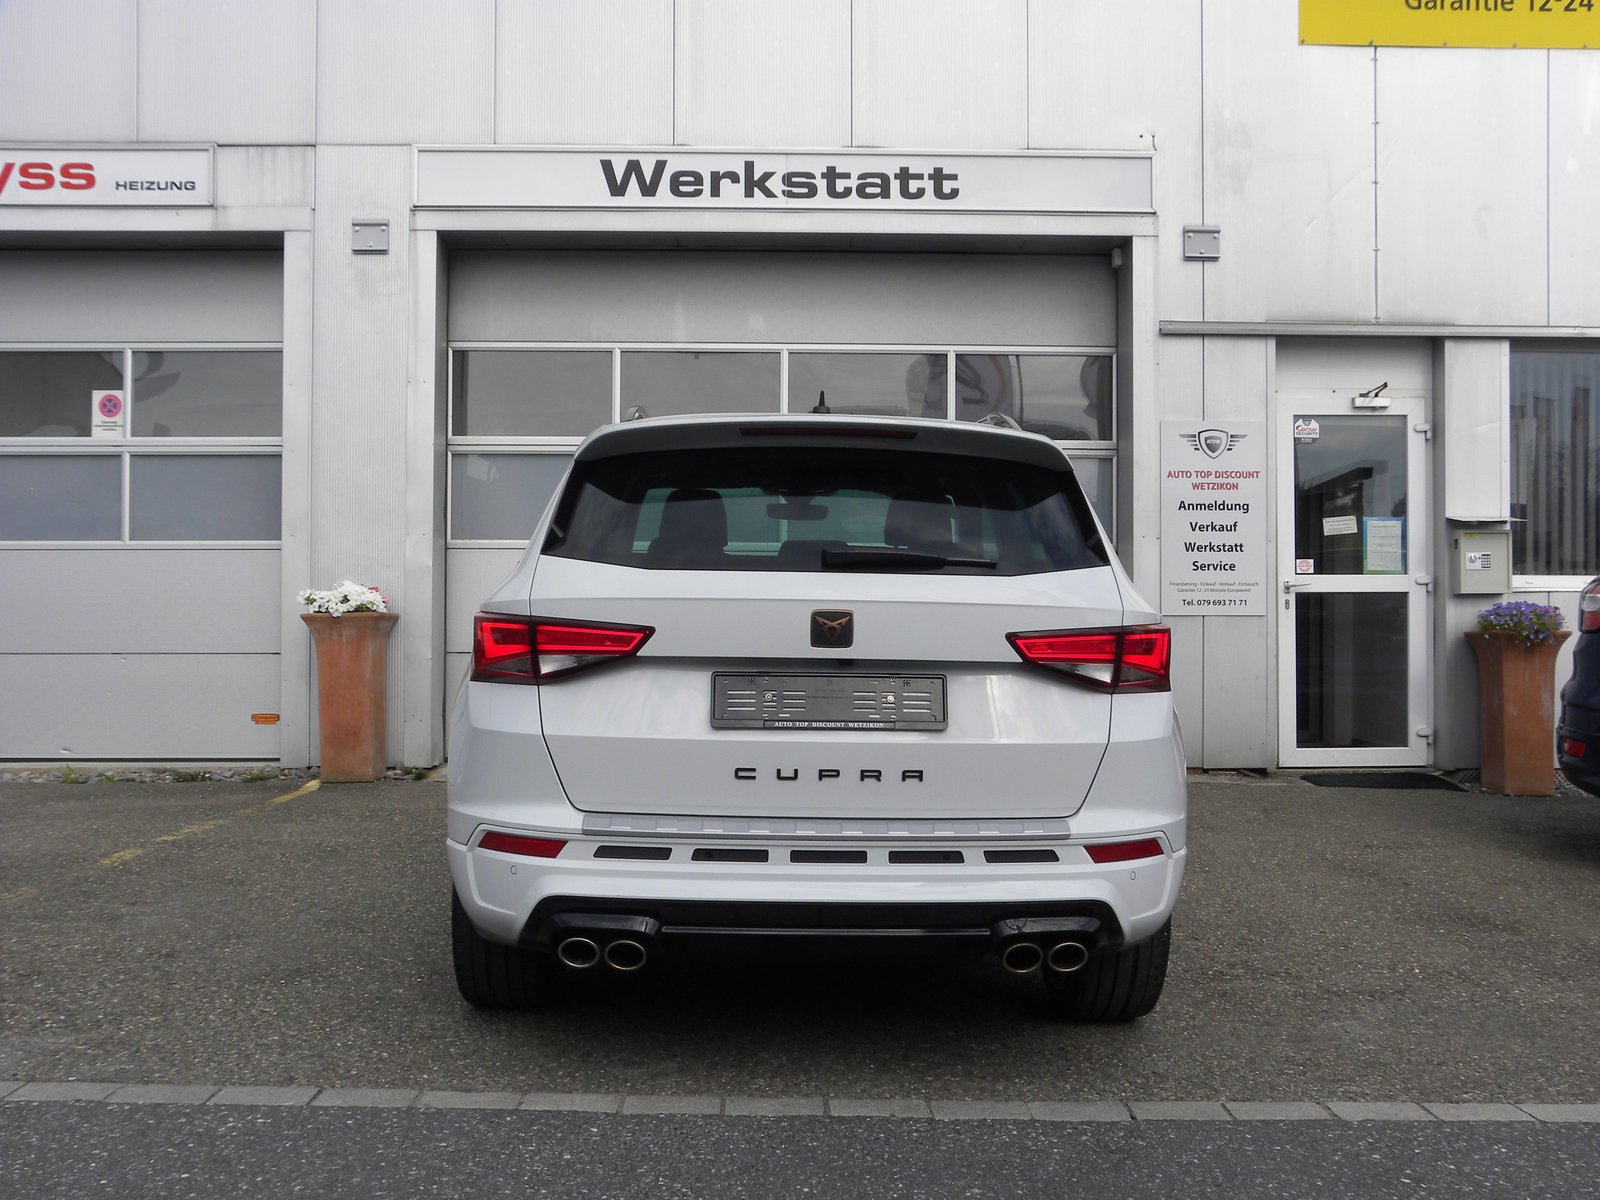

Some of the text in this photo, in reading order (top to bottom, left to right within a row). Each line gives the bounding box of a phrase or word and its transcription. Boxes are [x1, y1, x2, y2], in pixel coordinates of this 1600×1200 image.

[115, 180, 196, 191] HEIZUNG
[600, 159, 960, 201] Werkstatt
[1167, 470, 1261, 479] AUTO TOP DISCOUNT
[1191, 482, 1239, 491] WETZIKON
[1178, 500, 1250, 514] Anmeldung
[1189, 521, 1238, 532] Verkauf
[1184, 541, 1244, 553] Werkstatt
[1192, 560, 1236, 572] Service
[734, 767, 924, 782] CUPRA
